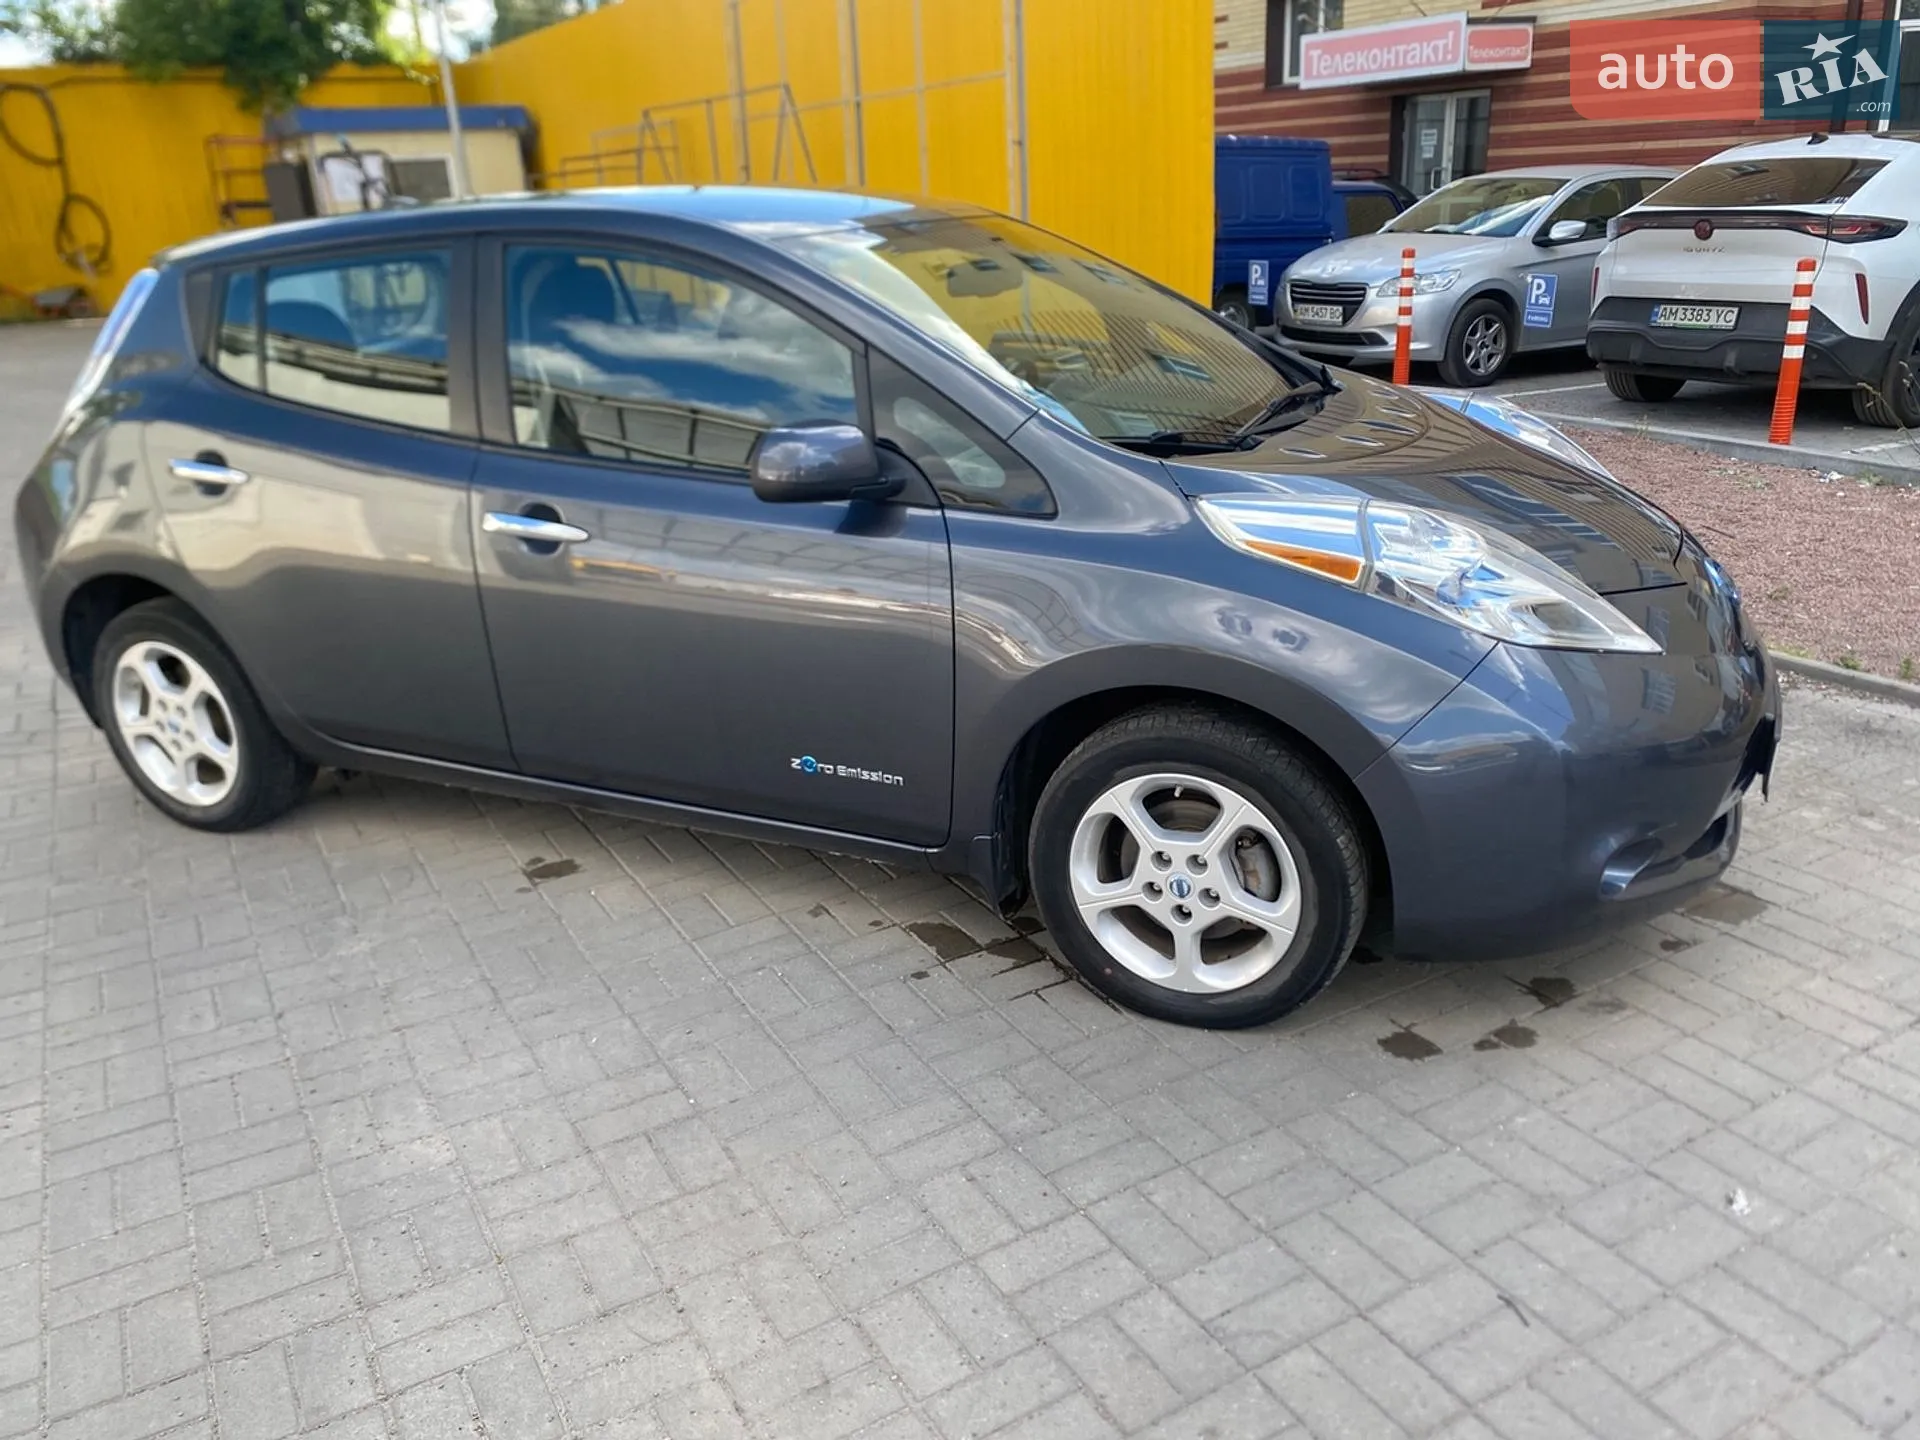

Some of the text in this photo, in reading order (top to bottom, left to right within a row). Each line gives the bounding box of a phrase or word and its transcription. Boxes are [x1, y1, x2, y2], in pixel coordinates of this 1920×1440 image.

[1309, 30, 1454, 77] Телеконтакт!
[1531, 278, 1546, 304] P
[1659, 307, 1735, 324] AM 3383 YC
[836, 765, 904, 786] Emission
